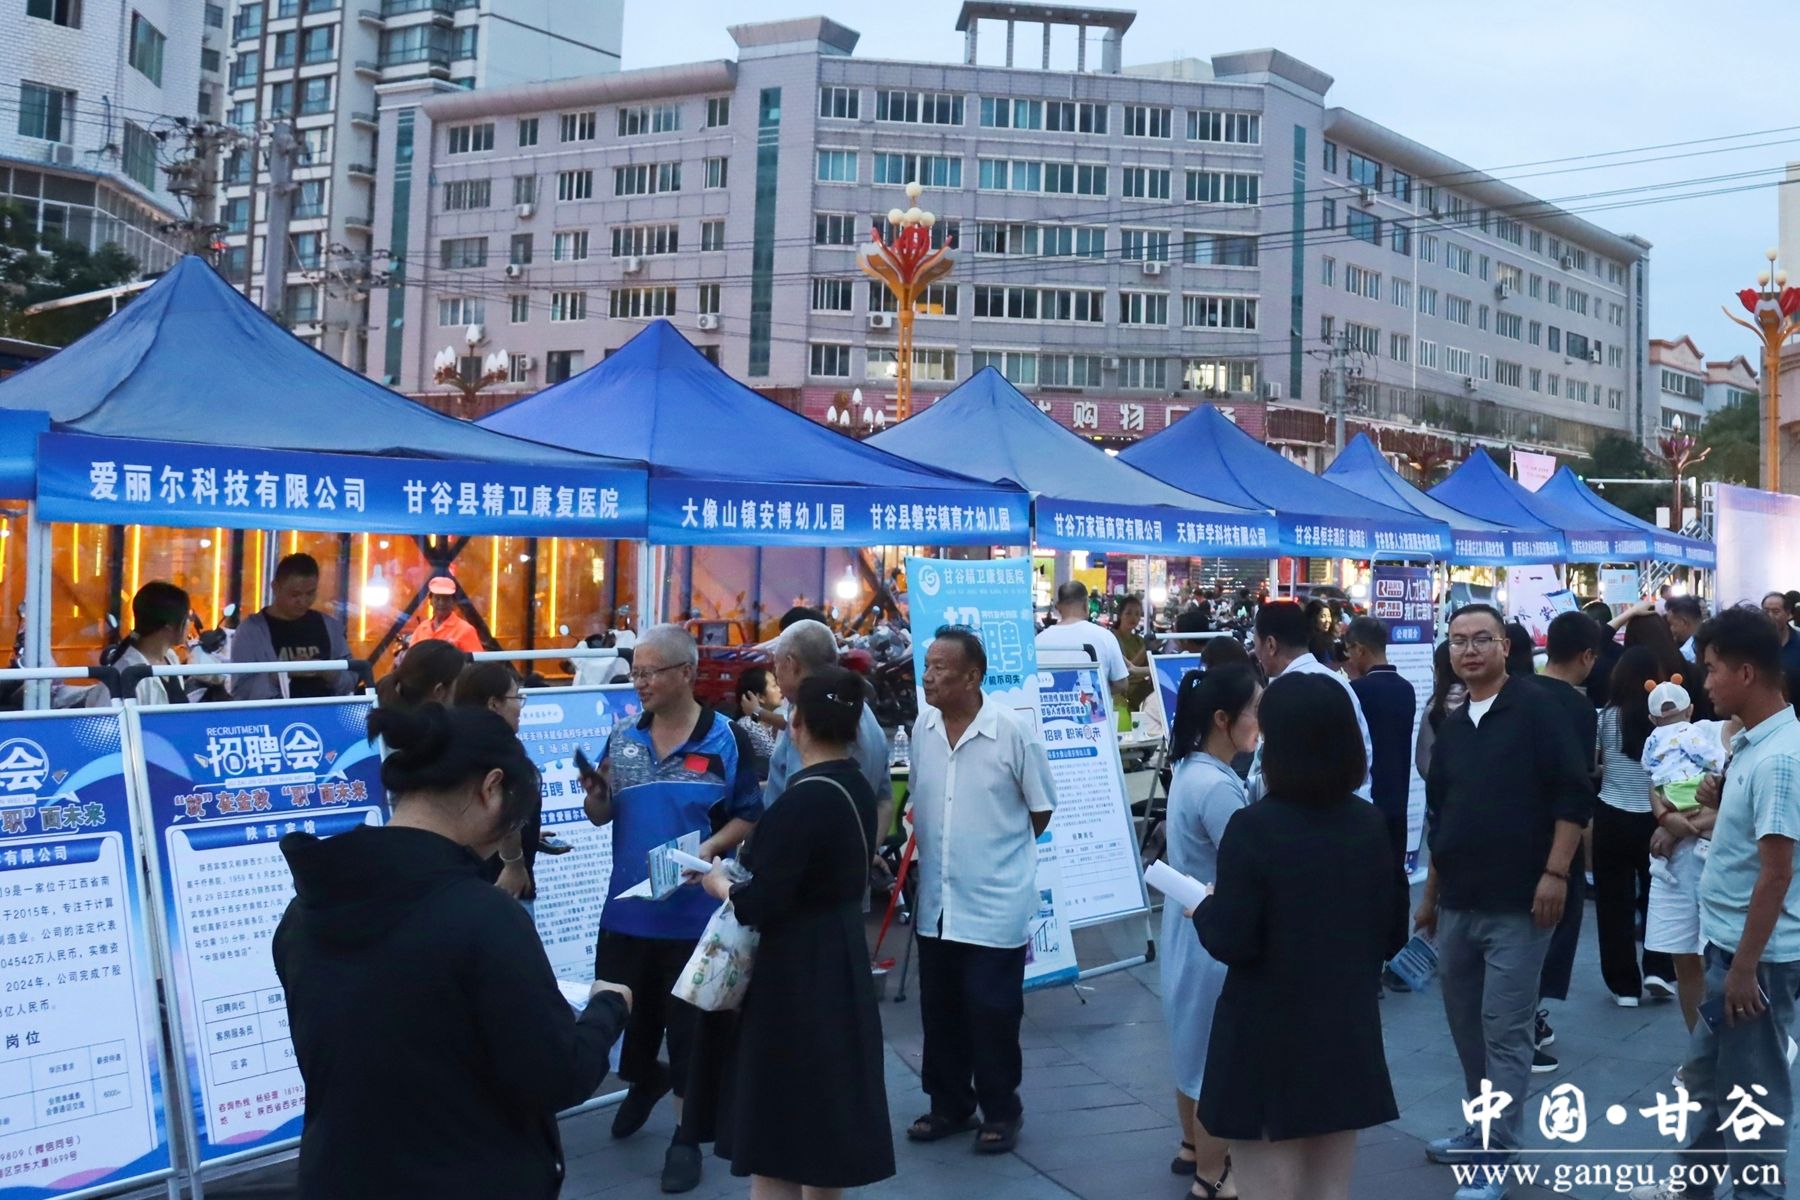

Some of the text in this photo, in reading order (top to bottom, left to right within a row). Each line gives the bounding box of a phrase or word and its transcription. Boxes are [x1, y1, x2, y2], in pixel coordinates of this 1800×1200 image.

[89, 461, 620, 519] 爱丽尔科技有限公司 甘谷县精卫康复医院
[681, 497, 1010, 532] 大像山镇安博幼儿园 甘谷县磐安镇育才幼儿园
[1054, 513, 1163, 543] 甘谷万家福商贸有限公司
[944, 568, 1025, 585] 甘谷精卫康复医院
[207, 725, 265, 736] RECRUITMENT
[1044, 729, 1062, 742] 招聘
[207, 725, 323, 777] 招聘会
[0, 747, 44, 792] 会
[216, 1001, 246, 1015] 招聘岗位
[6, 1031, 40, 1049] 岗位
[216, 1025, 254, 1041] 客房服务员
